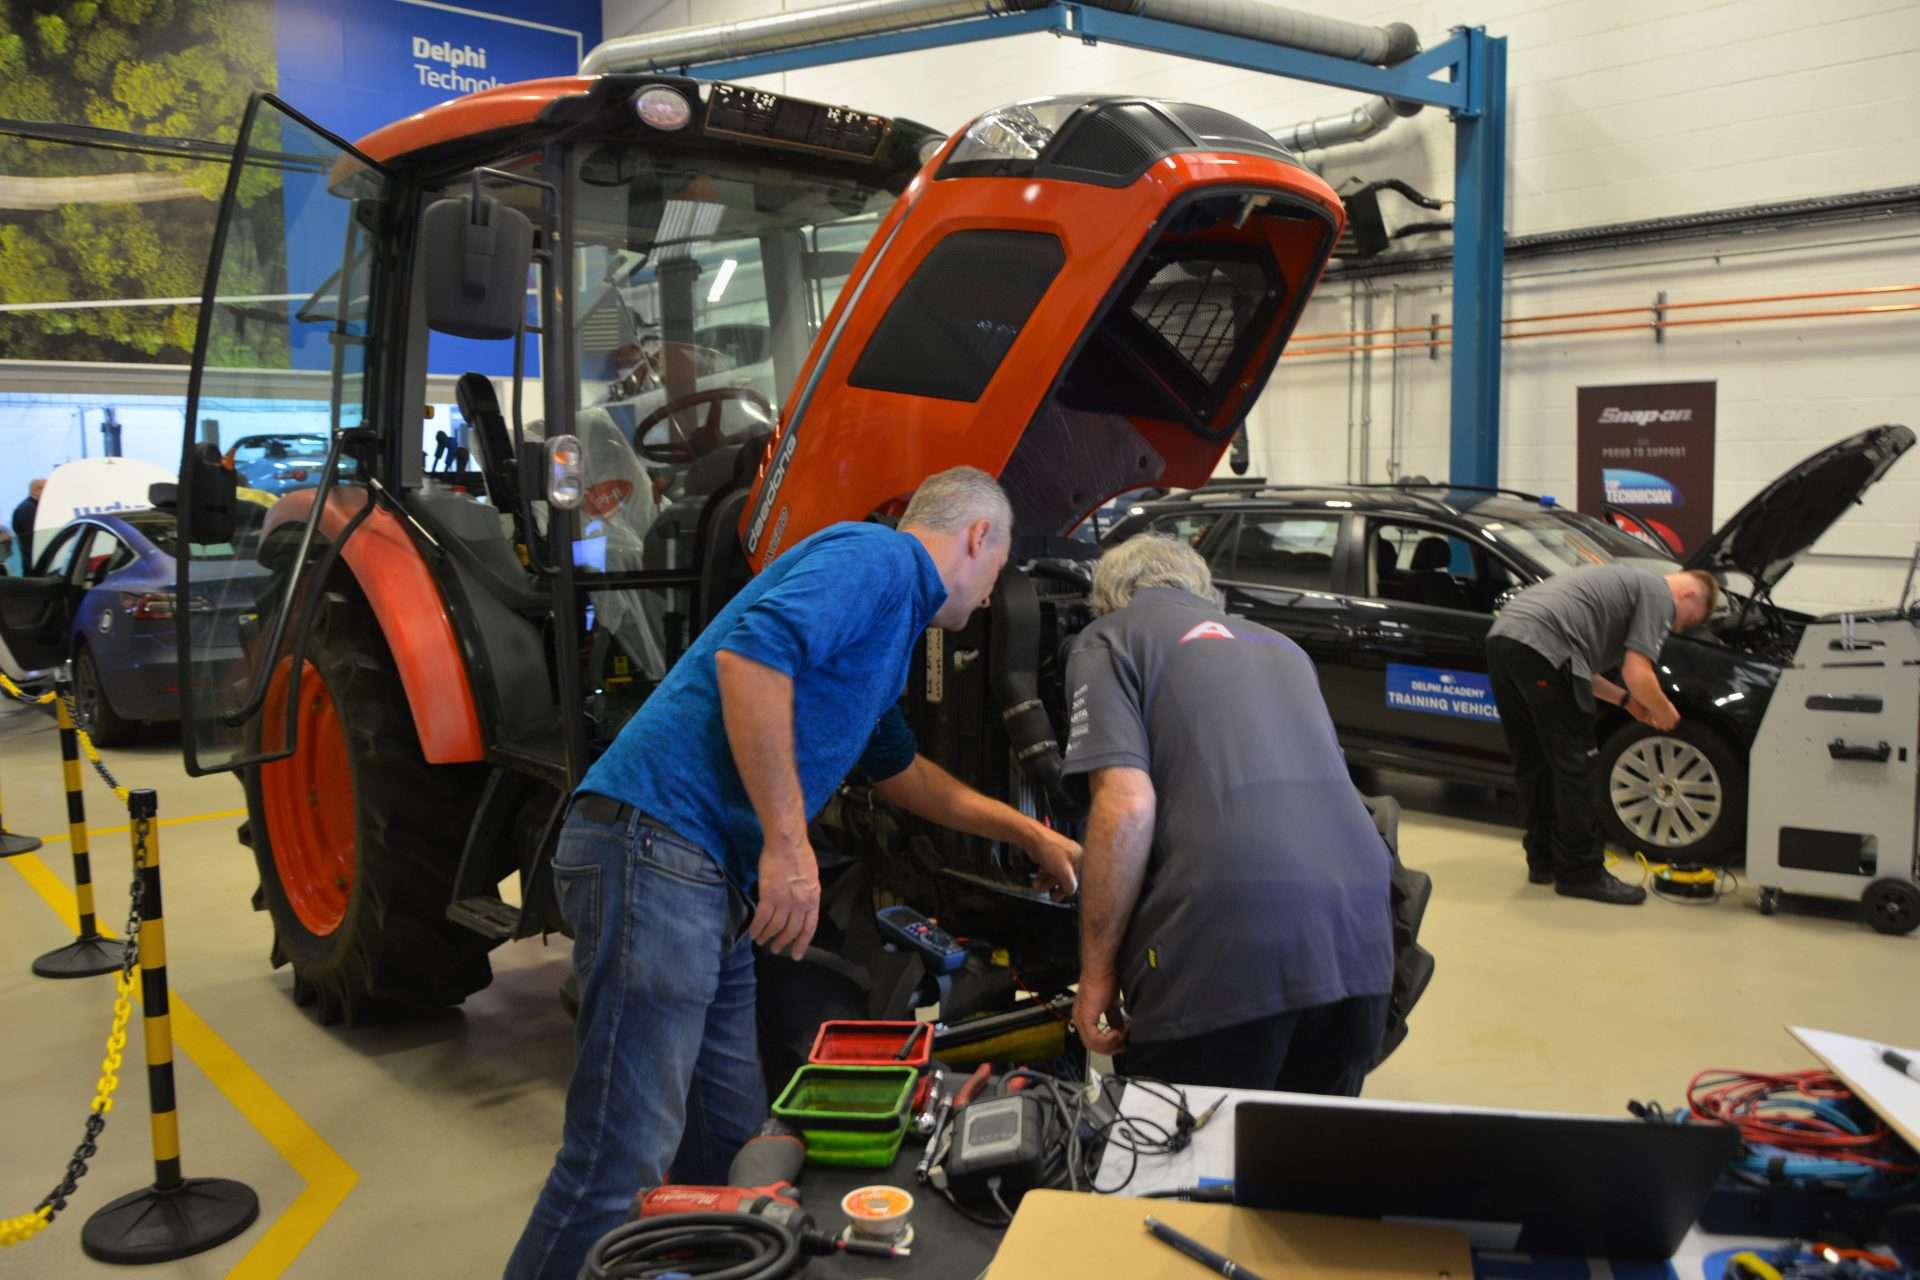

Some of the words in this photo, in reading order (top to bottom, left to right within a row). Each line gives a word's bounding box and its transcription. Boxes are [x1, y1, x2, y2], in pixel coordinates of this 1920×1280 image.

[412, 36, 486, 69] Delphi
[1598, 406, 1693, 426] Snap-on
[1411, 680, 1442, 695] DELPHI
[1443, 684, 1485, 699] ACADEMY
[1388, 691, 1449, 711] TRAINING
